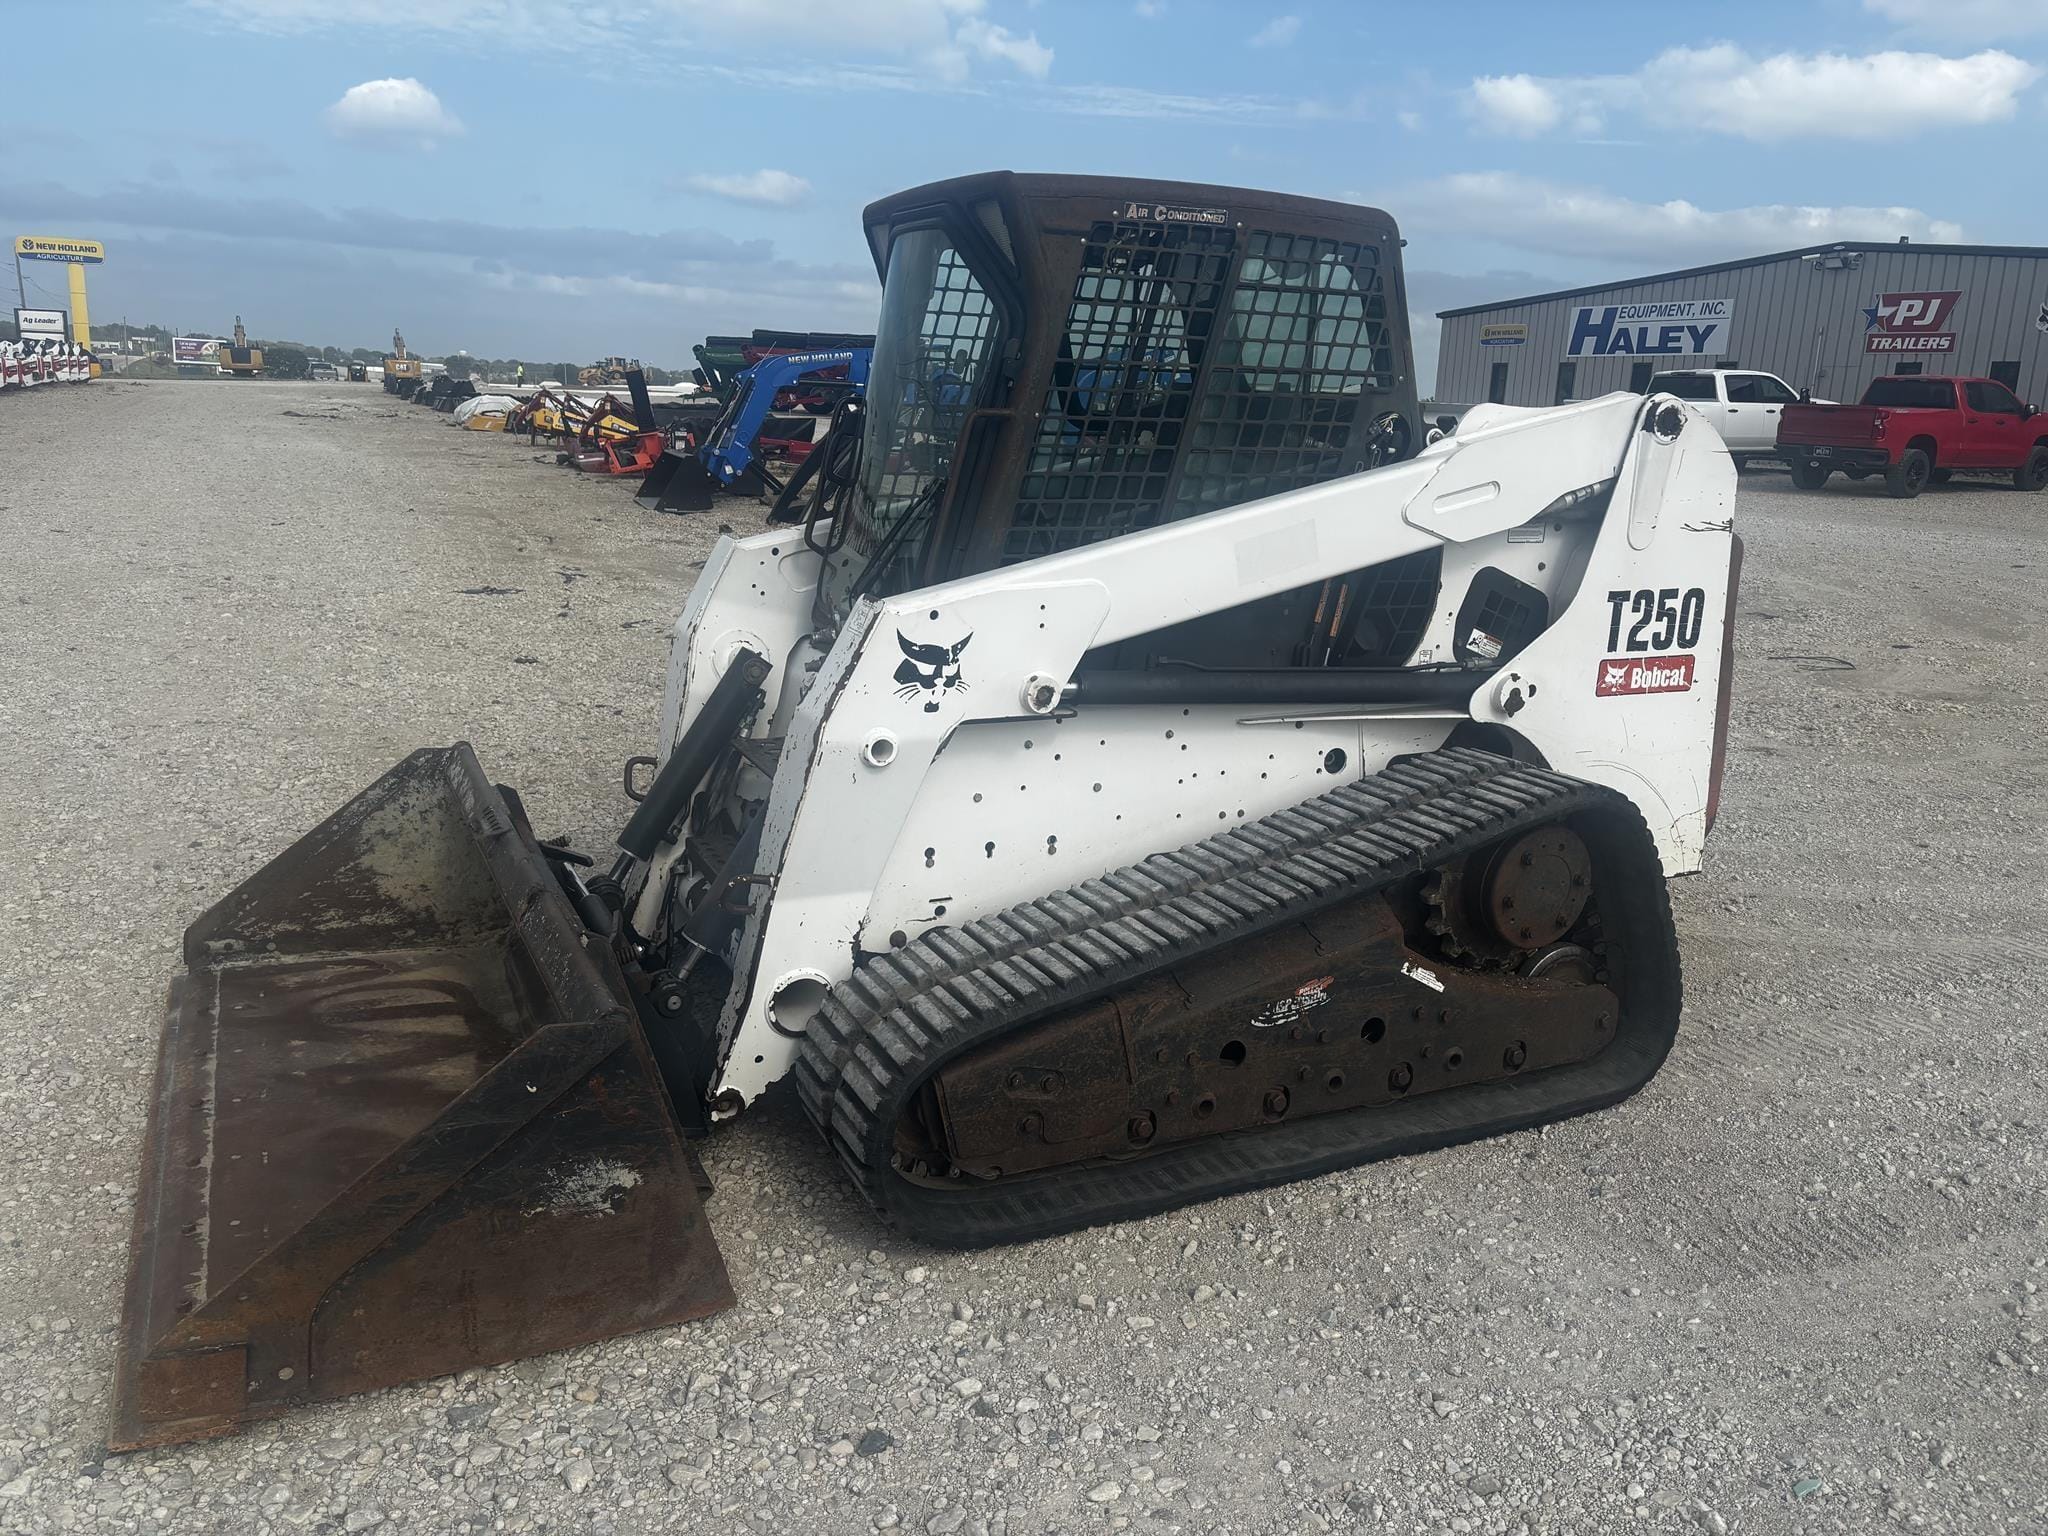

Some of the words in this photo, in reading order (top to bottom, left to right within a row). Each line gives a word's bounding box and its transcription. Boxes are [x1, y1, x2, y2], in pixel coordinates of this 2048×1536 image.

[36, 243, 56, 251] NEW
[58, 244, 97, 253] HOLLAND
[37, 253, 83, 261] AGRICULTURE
[1618, 303, 1695, 319] EQUIPMENT,
[1700, 301, 1726, 316] INC.
[1892, 299, 1942, 326] PJ
[1568, 306, 1718, 356] HALEY
[1871, 336, 1952, 350] TRAILERS
[788, 355, 809, 364] NEW
[811, 352, 853, 361] HOLLAND
[1606, 588, 1705, 652] T250
[1630, 665, 1686, 689] Bobcat
